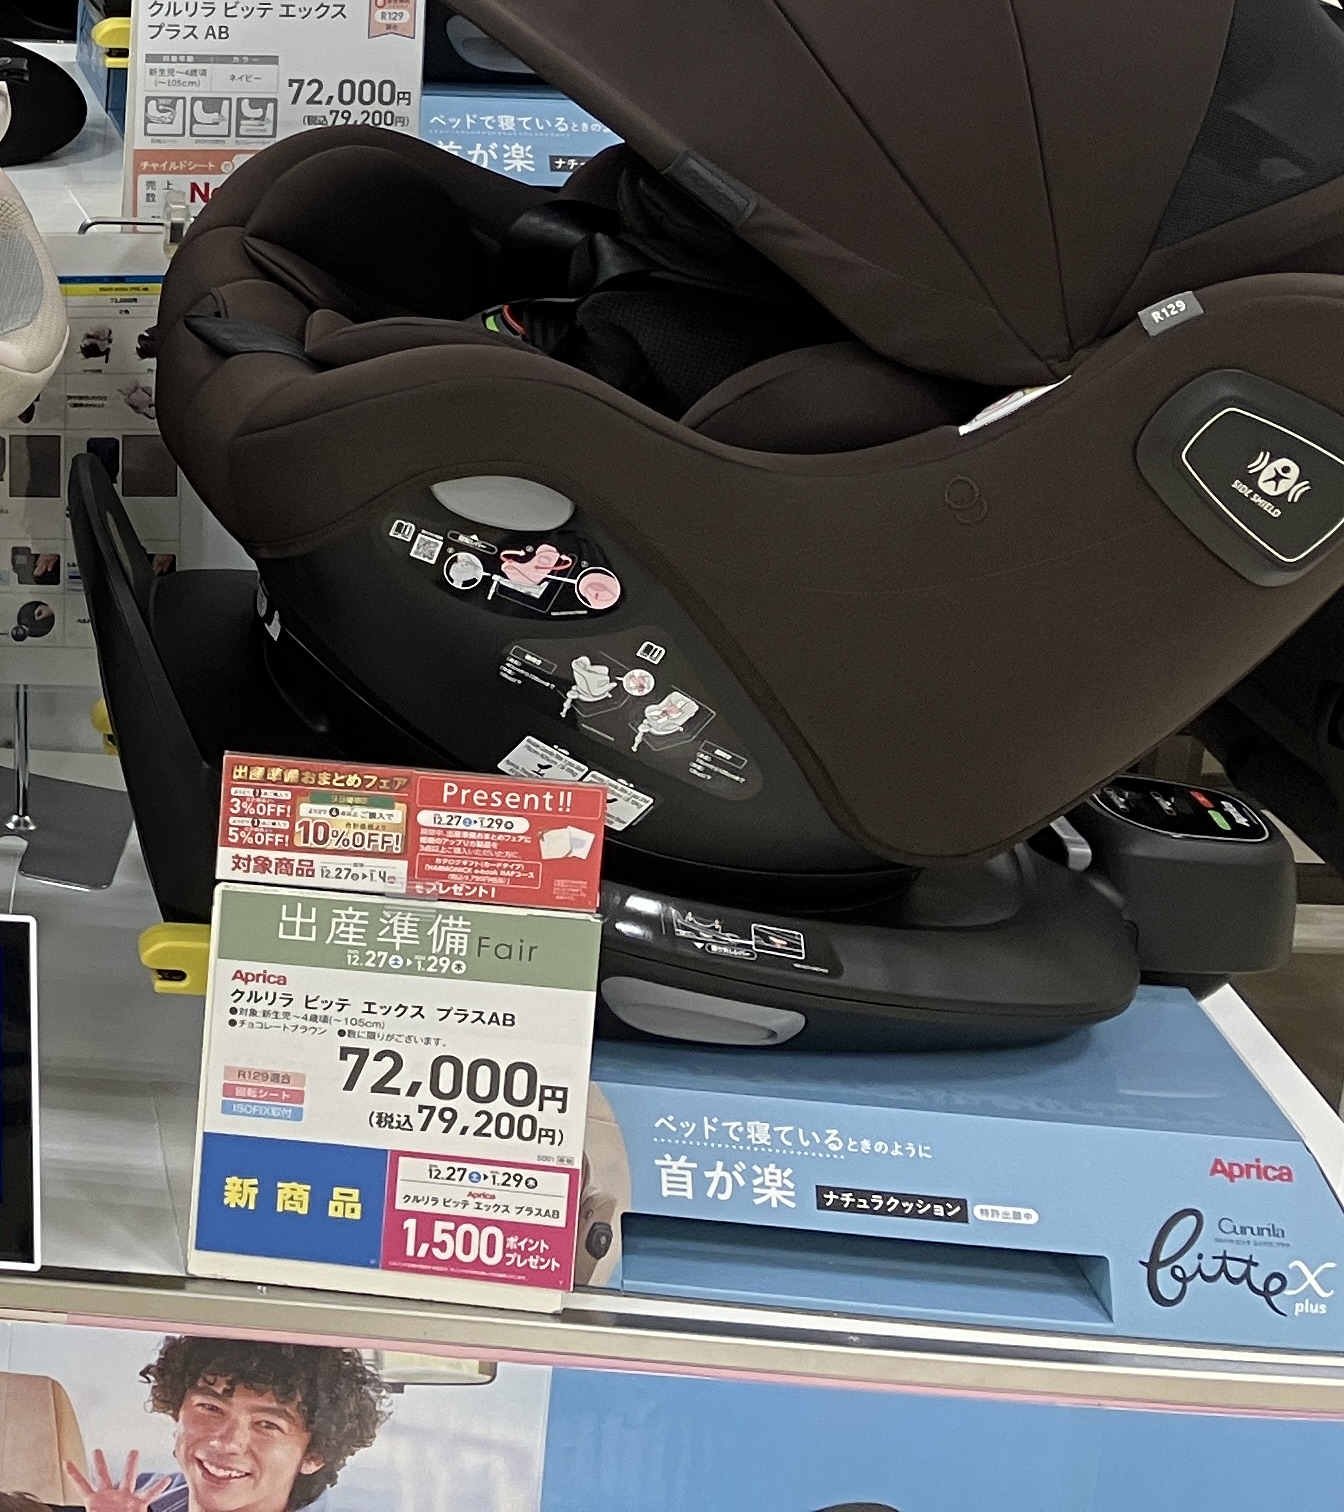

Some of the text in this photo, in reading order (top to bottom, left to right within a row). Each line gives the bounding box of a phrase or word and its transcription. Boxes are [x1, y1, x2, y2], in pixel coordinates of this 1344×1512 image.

[148, 0, 347, 20] クルリラ ビッテ エックス
[148, 21, 230, 41] プラス AB
[288, 78, 411, 106] 72,000円
[1151, 300, 1186, 323] R129
[1231, 479, 1282, 518] SIDE SHIELD
[443, 783, 573, 813] Present!!
[296, 820, 402, 852] 10%OFF!
[232, 855, 316, 878] 対象商品
[277, 902, 539, 964] 出産準備 Fair
[231, 969, 287, 987] Aprica
[230, 989, 516, 1028] クルリラ ビッテ エックス プラスAB
[337, 1045, 569, 1114] 72,000円
[368, 1105, 564, 1148] (税込79,200円)
[654, 1113, 934, 1161] ベッドで寝ているときのように
[654, 1153, 798, 1210] 首が楽
[1208, 1156, 1295, 1184] Aprica
[222, 1175, 364, 1221] 新商品
[822, 1190, 962, 1217] ナチュラクッション
[402, 1218, 504, 1266] 1,500
[1217, 1216, 1285, 1240] Cururila
[1293, 1298, 1328, 1317] plus
